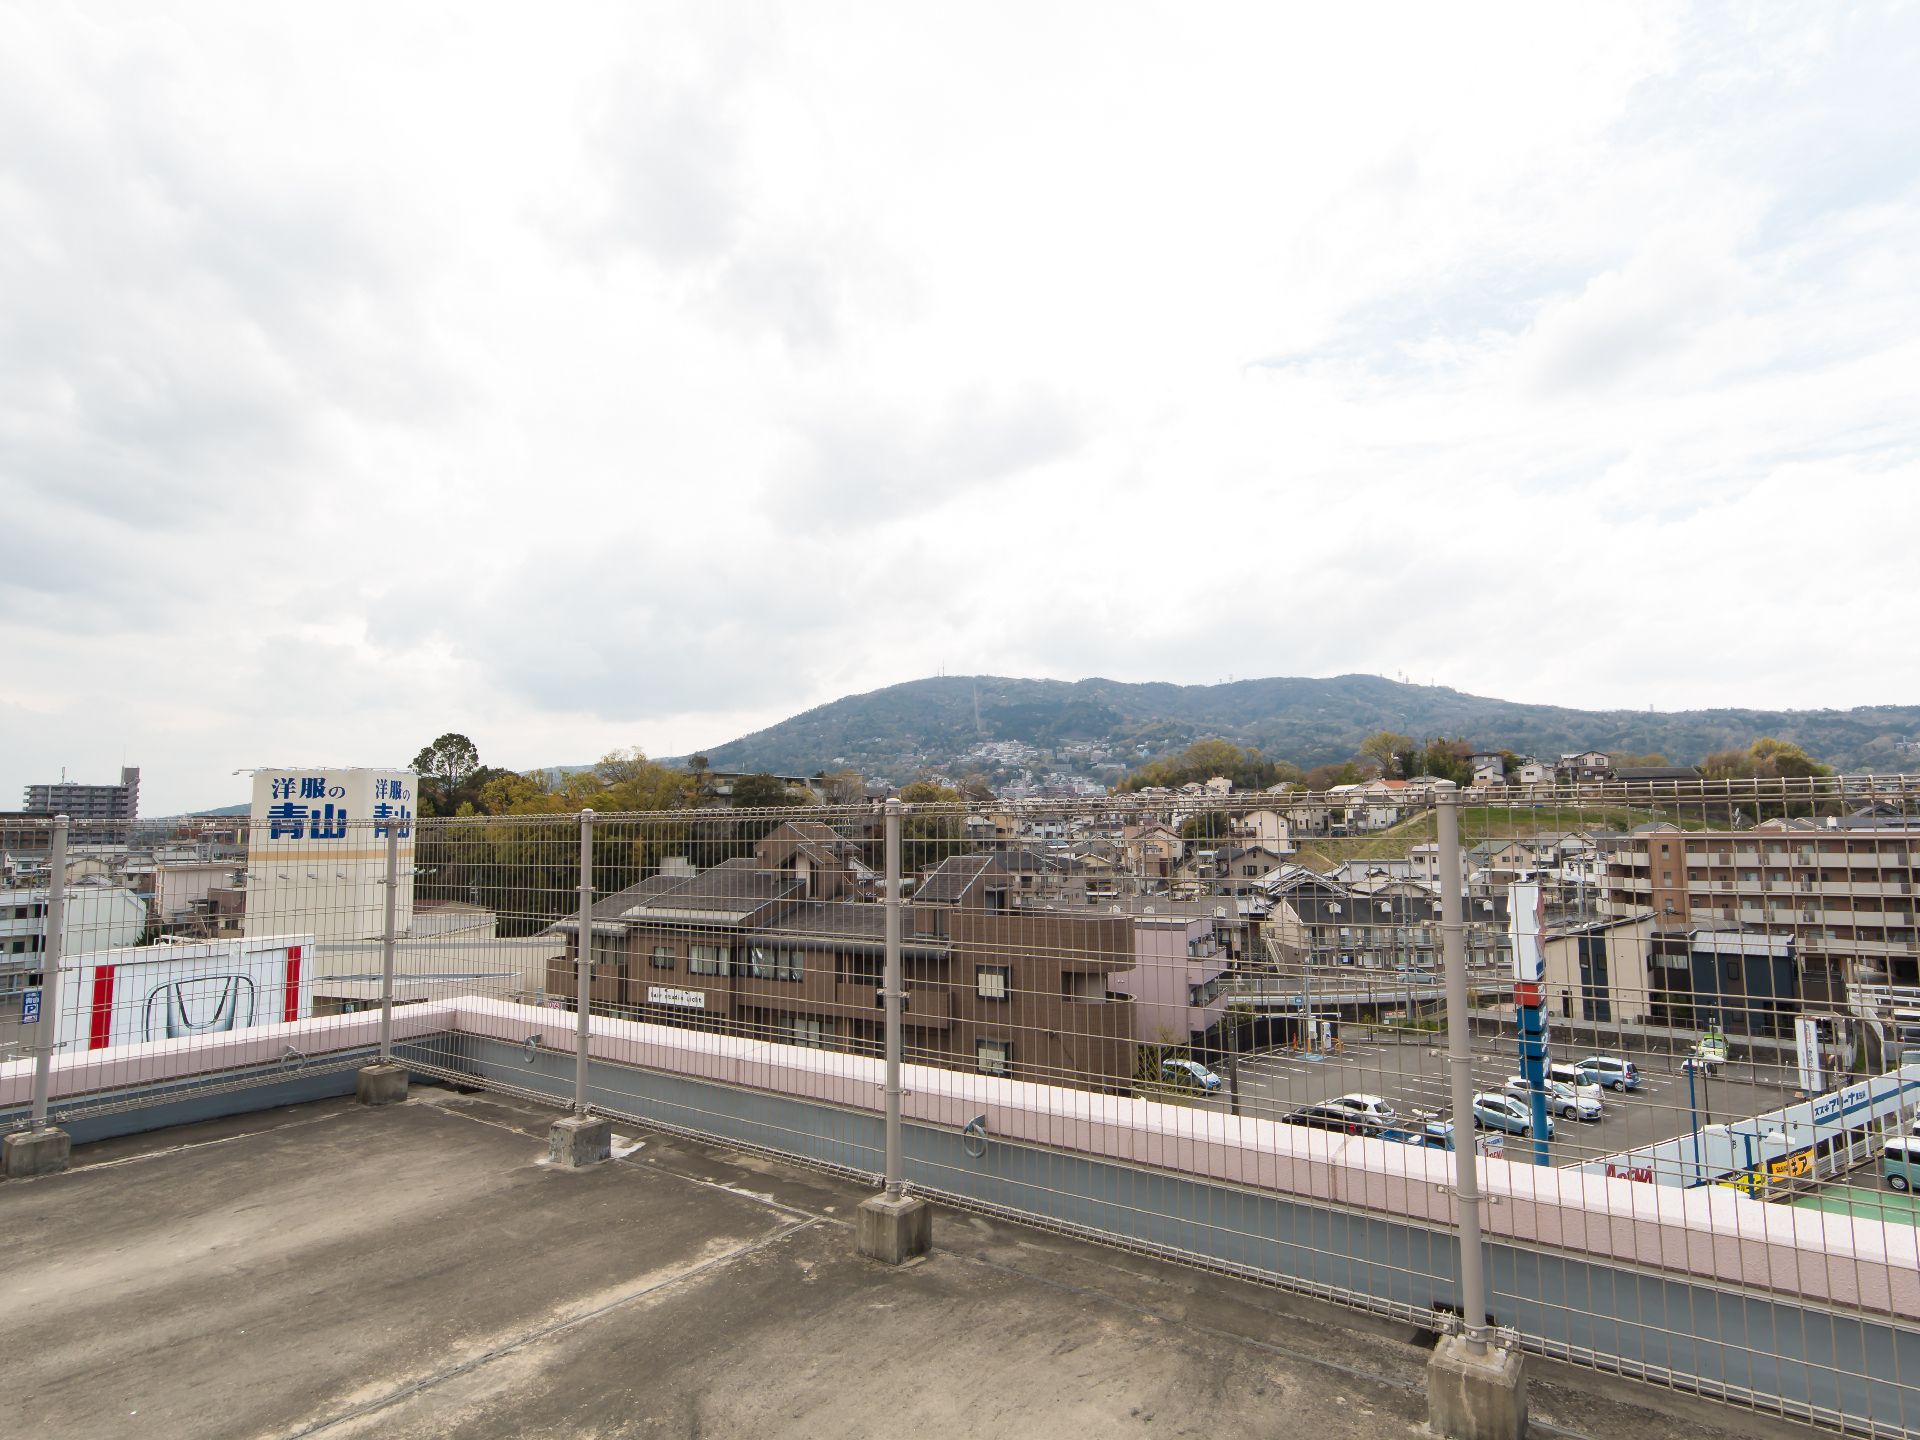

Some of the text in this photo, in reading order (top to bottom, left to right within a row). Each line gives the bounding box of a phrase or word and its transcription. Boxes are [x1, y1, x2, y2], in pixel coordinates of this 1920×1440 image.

[271, 777, 346, 800] 洋服の
[375, 778, 411, 801] 洋服の
[267, 802, 347, 840] 青山
[373, 802, 411, 839] 青山
